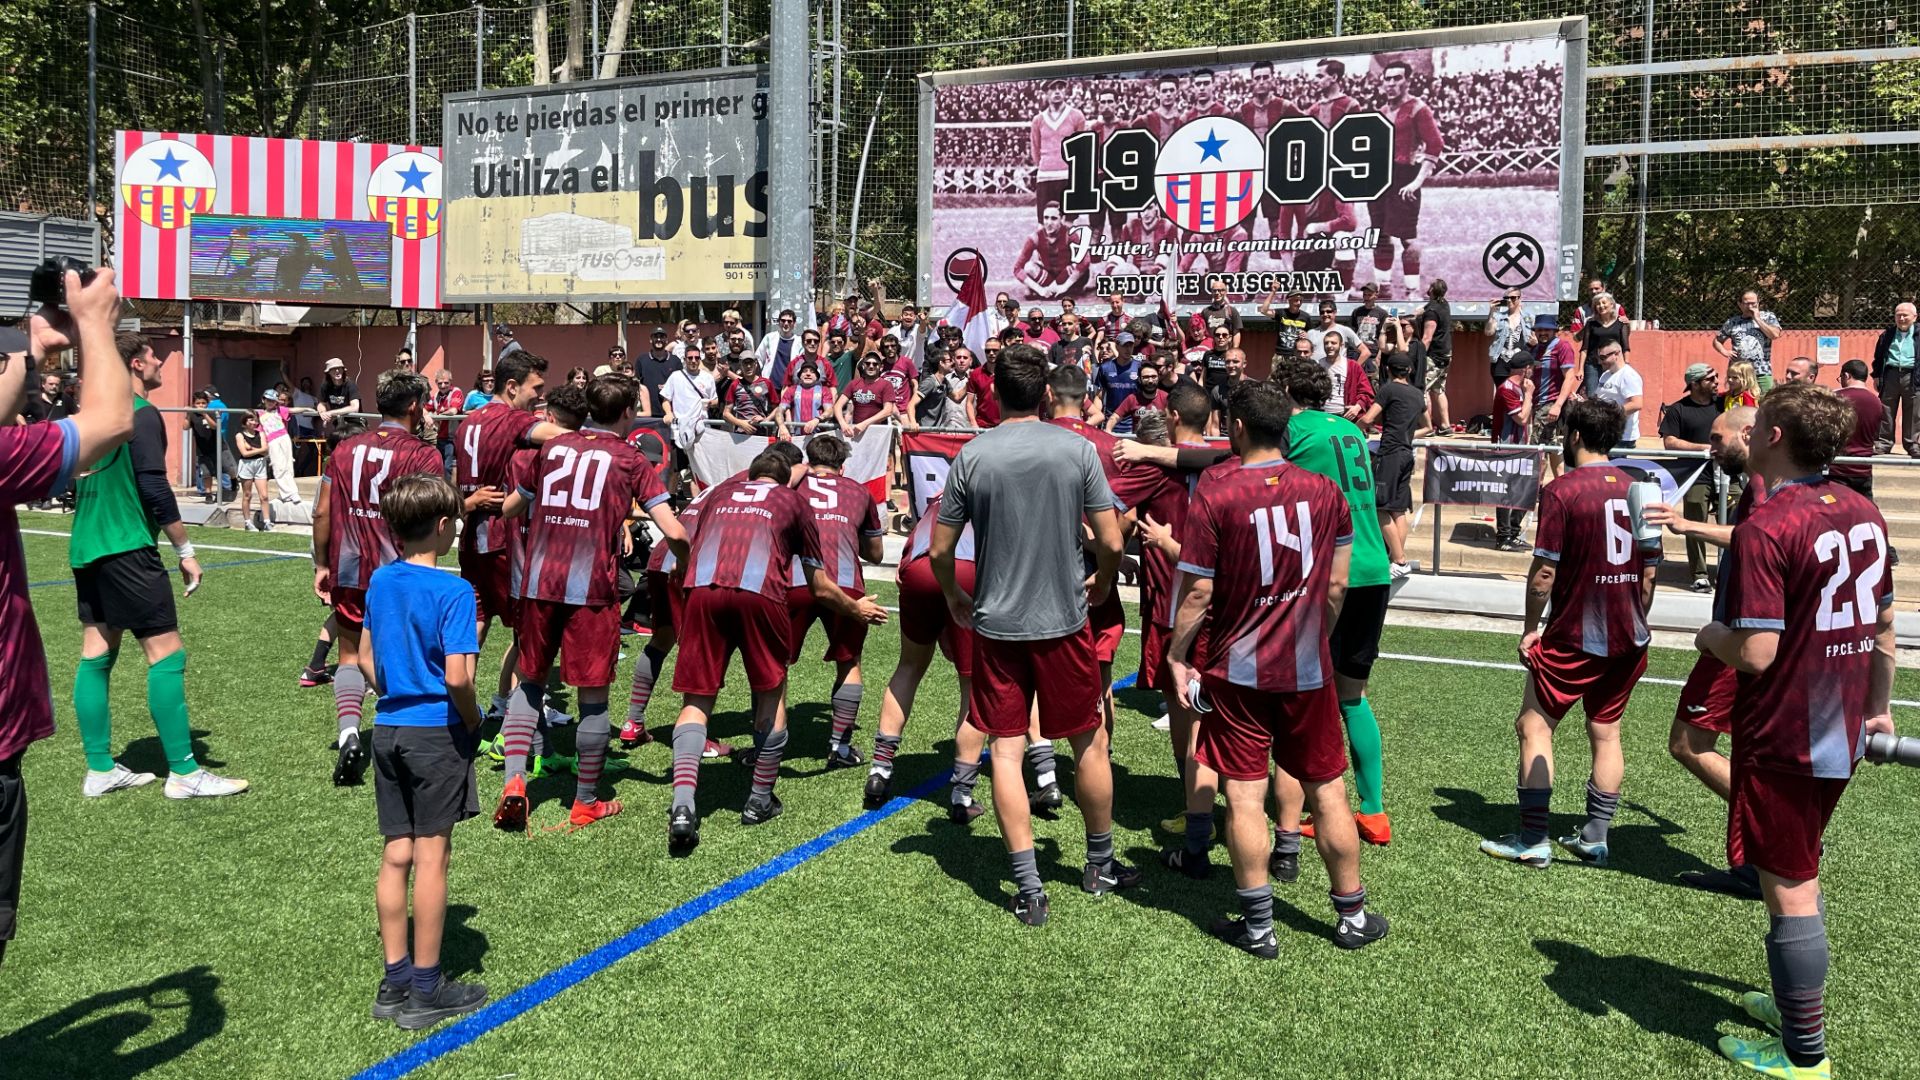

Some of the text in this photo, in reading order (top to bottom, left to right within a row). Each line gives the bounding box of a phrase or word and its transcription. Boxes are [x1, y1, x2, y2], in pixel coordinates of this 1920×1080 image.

[458, 112, 489, 136] No
[495, 111, 518, 133] te
[526, 101, 617, 137] pierdas
[624, 94, 646, 122] el
[655, 91, 743, 127] primer
[474, 158, 579, 198] Utiliza
[591, 153, 619, 193] el
[1069, 225, 1153, 264] Júpiter,
[1184, 238, 1223, 253] mai
[1227, 232, 1337, 252] caminaràs
[1340, 227, 1381, 249] sol!
[725, 271, 744, 280] 901
[747, 271, 759, 280] 51
[352, 444, 394, 505] 17
[464, 424, 482, 478] 4
[1329, 435, 1372, 493] 13
[541, 445, 613, 511] 20
[807, 476, 838, 509] 5
[1451, 480, 1509, 494] JUPITER
[1250, 501, 1314, 587] 14
[1605, 499, 1632, 566] 6
[1814, 522, 1887, 632] 22
[1858, 636, 1874, 653] JÚ
